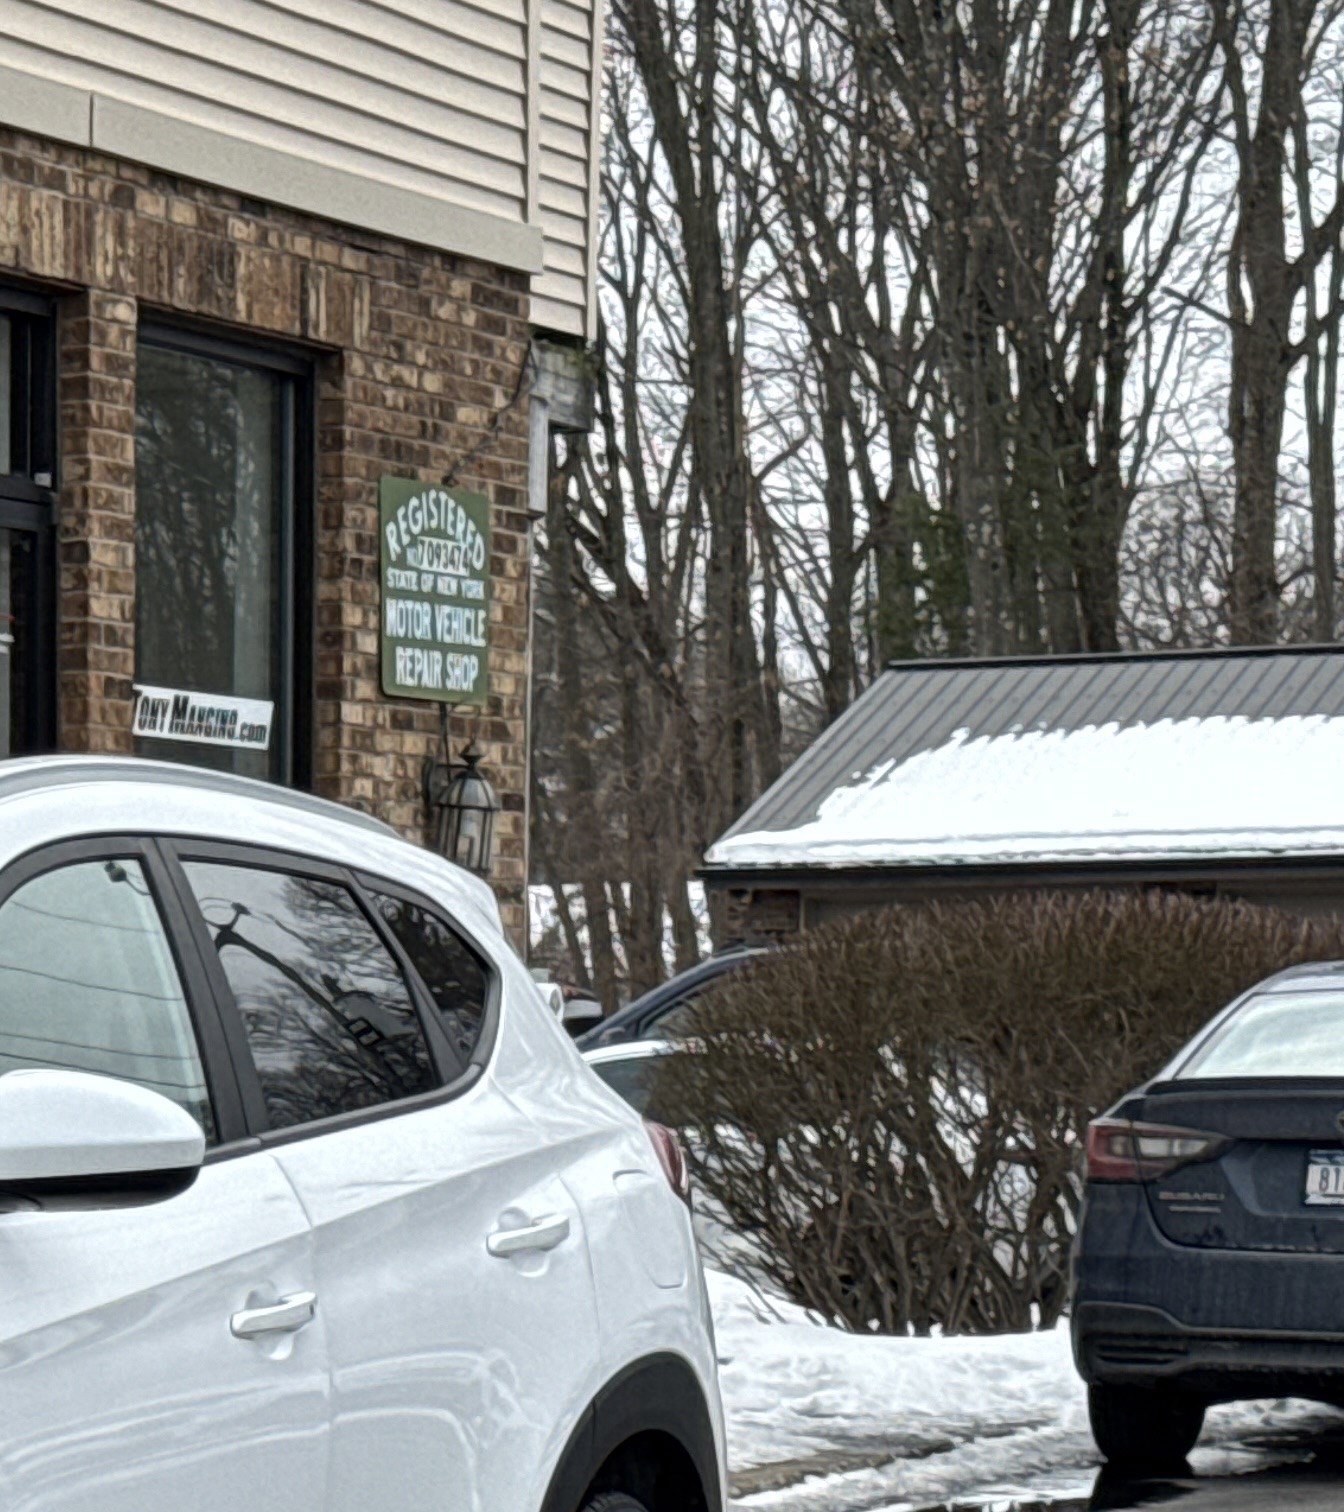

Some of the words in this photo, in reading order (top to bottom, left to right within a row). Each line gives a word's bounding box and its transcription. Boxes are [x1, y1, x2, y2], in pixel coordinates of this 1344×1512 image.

[386, 489, 484, 571] REGISTERED
[387, 567, 418, 592] STATE
[386, 598, 432, 640] MOTOR
[434, 604, 487, 648] VEHICLE
[396, 646, 443, 690] REPAIR
[446, 652, 479, 692] SHOP
